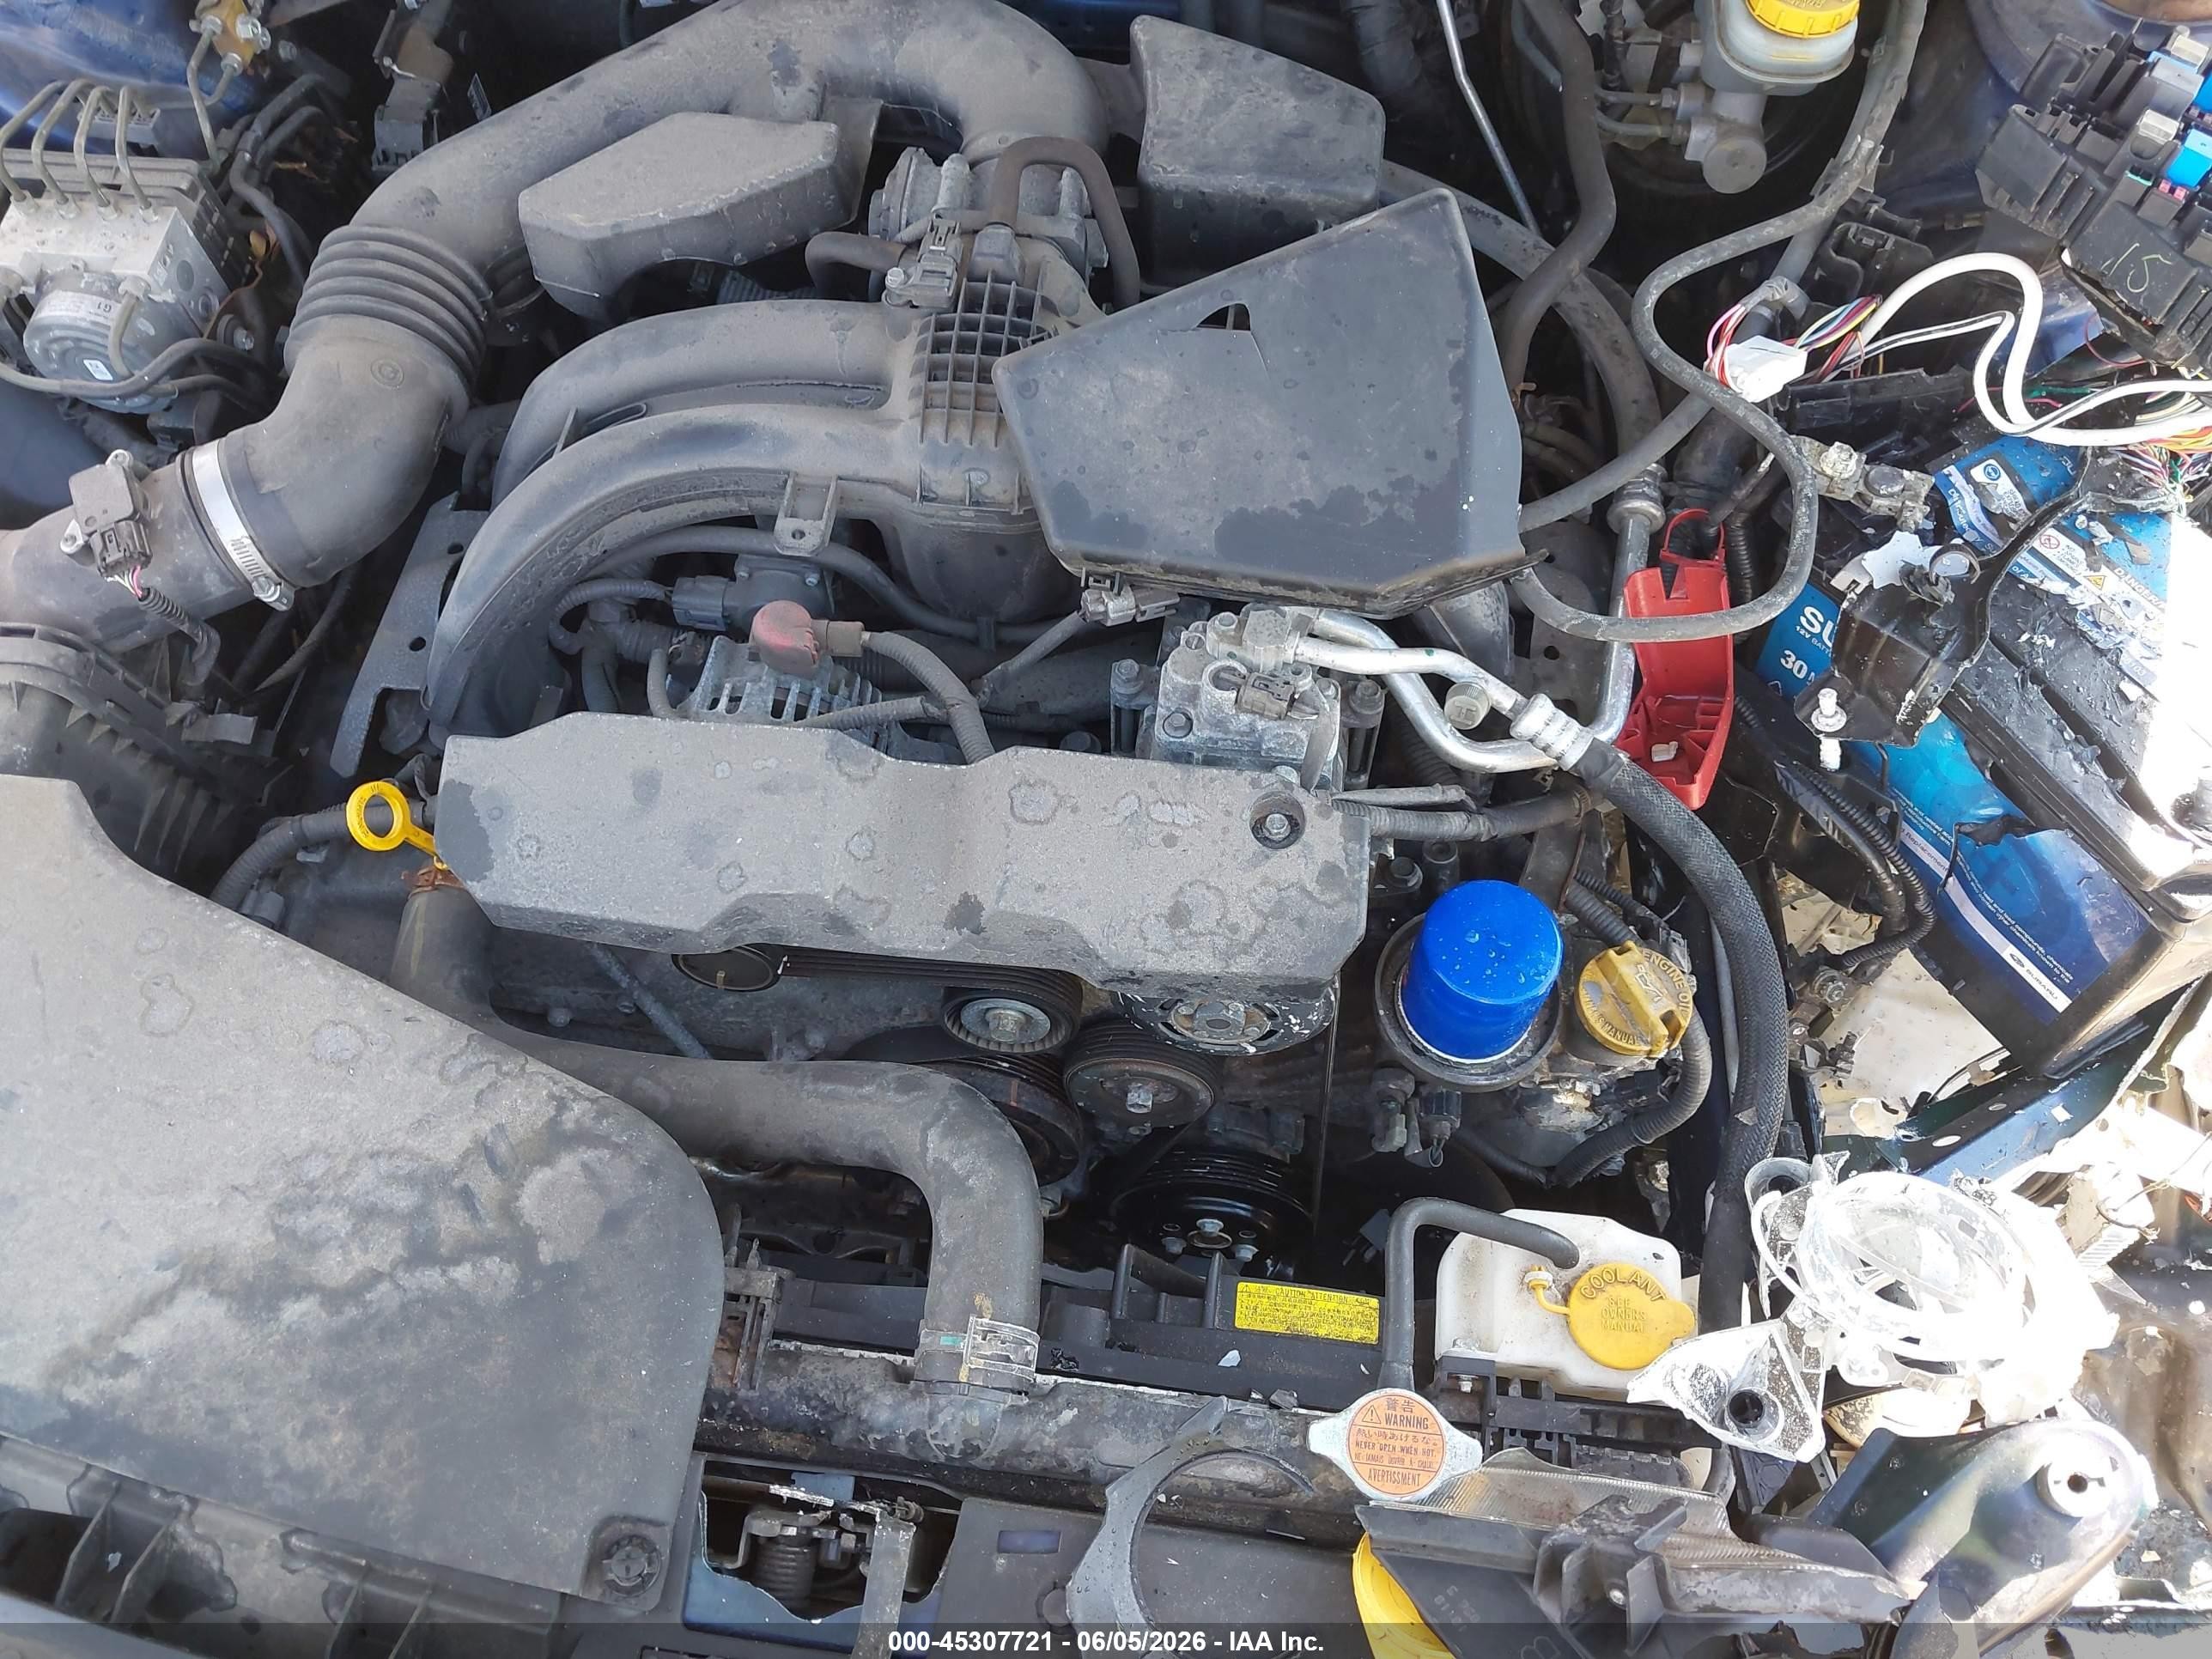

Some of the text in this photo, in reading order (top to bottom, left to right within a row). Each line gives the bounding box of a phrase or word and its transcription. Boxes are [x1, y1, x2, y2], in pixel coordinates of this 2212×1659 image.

[1796, 625, 1812, 639] 12V
[1780, 649, 1808, 679] 30
[1642, 950, 1684, 989] ENGINE
[2027, 969, 2058, 1000] SUBARU
[1580, 1267, 1667, 1302] COOLANT
[1608, 1297, 1631, 1307] SEE
[1386, 1397, 1415, 1413] 警告
[1384, 1413, 1429, 1430] WARNING
[1355, 1441, 1376, 1451] NEVER
[1379, 1443, 1396, 1454] OPEN
[1400, 1445, 1419, 1455] WHEN
